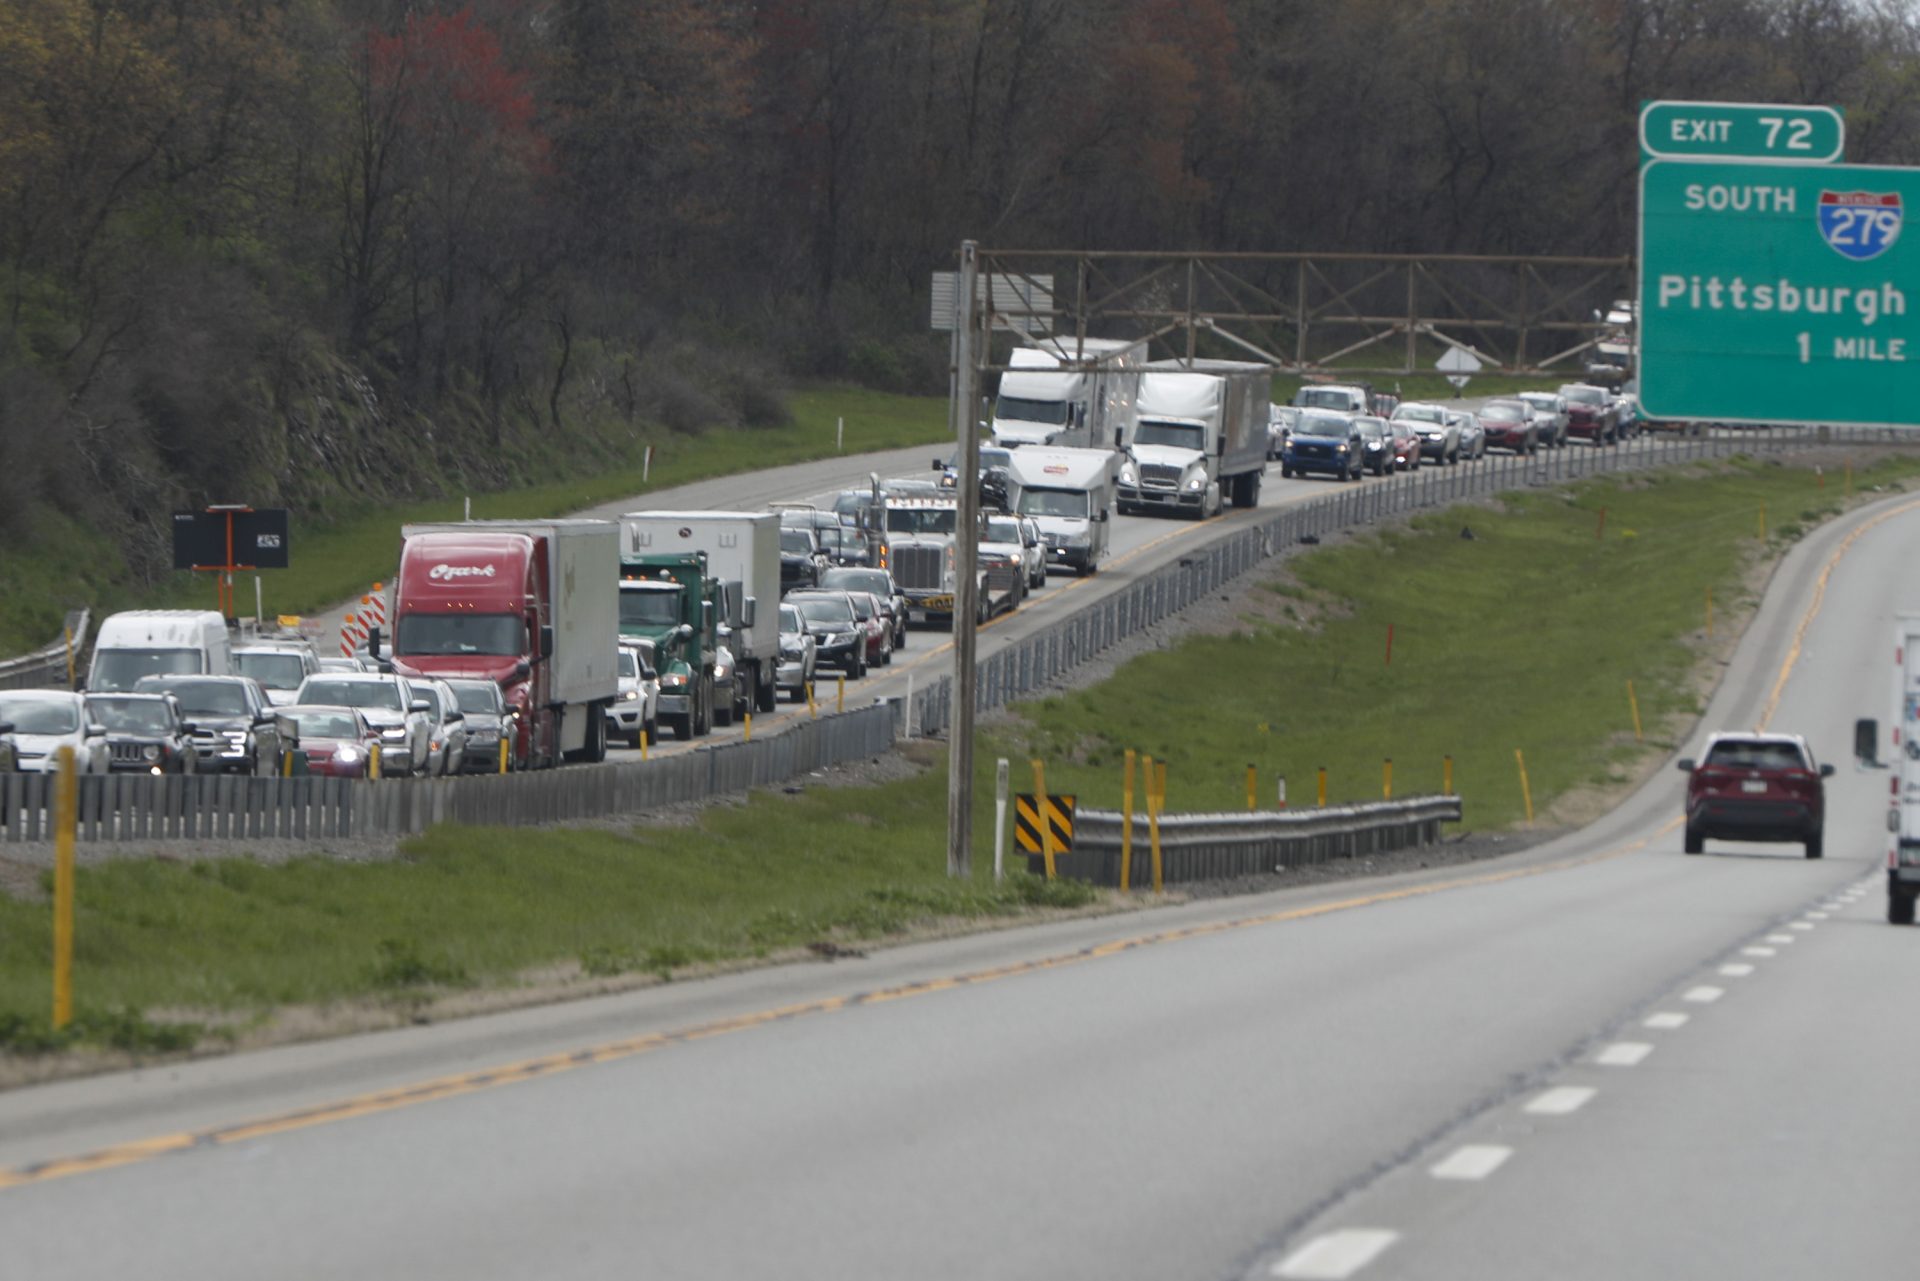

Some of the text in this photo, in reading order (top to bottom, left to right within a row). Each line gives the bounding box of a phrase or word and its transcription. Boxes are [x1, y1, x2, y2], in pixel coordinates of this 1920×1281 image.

[1671, 117, 1813, 149] EXIT 72
[1685, 184, 1796, 212] SOUTH
[1830, 207, 1900, 246] 279
[1658, 274, 1906, 326] Pittsburgh
[1797, 332, 1906, 363] 1 MILE
